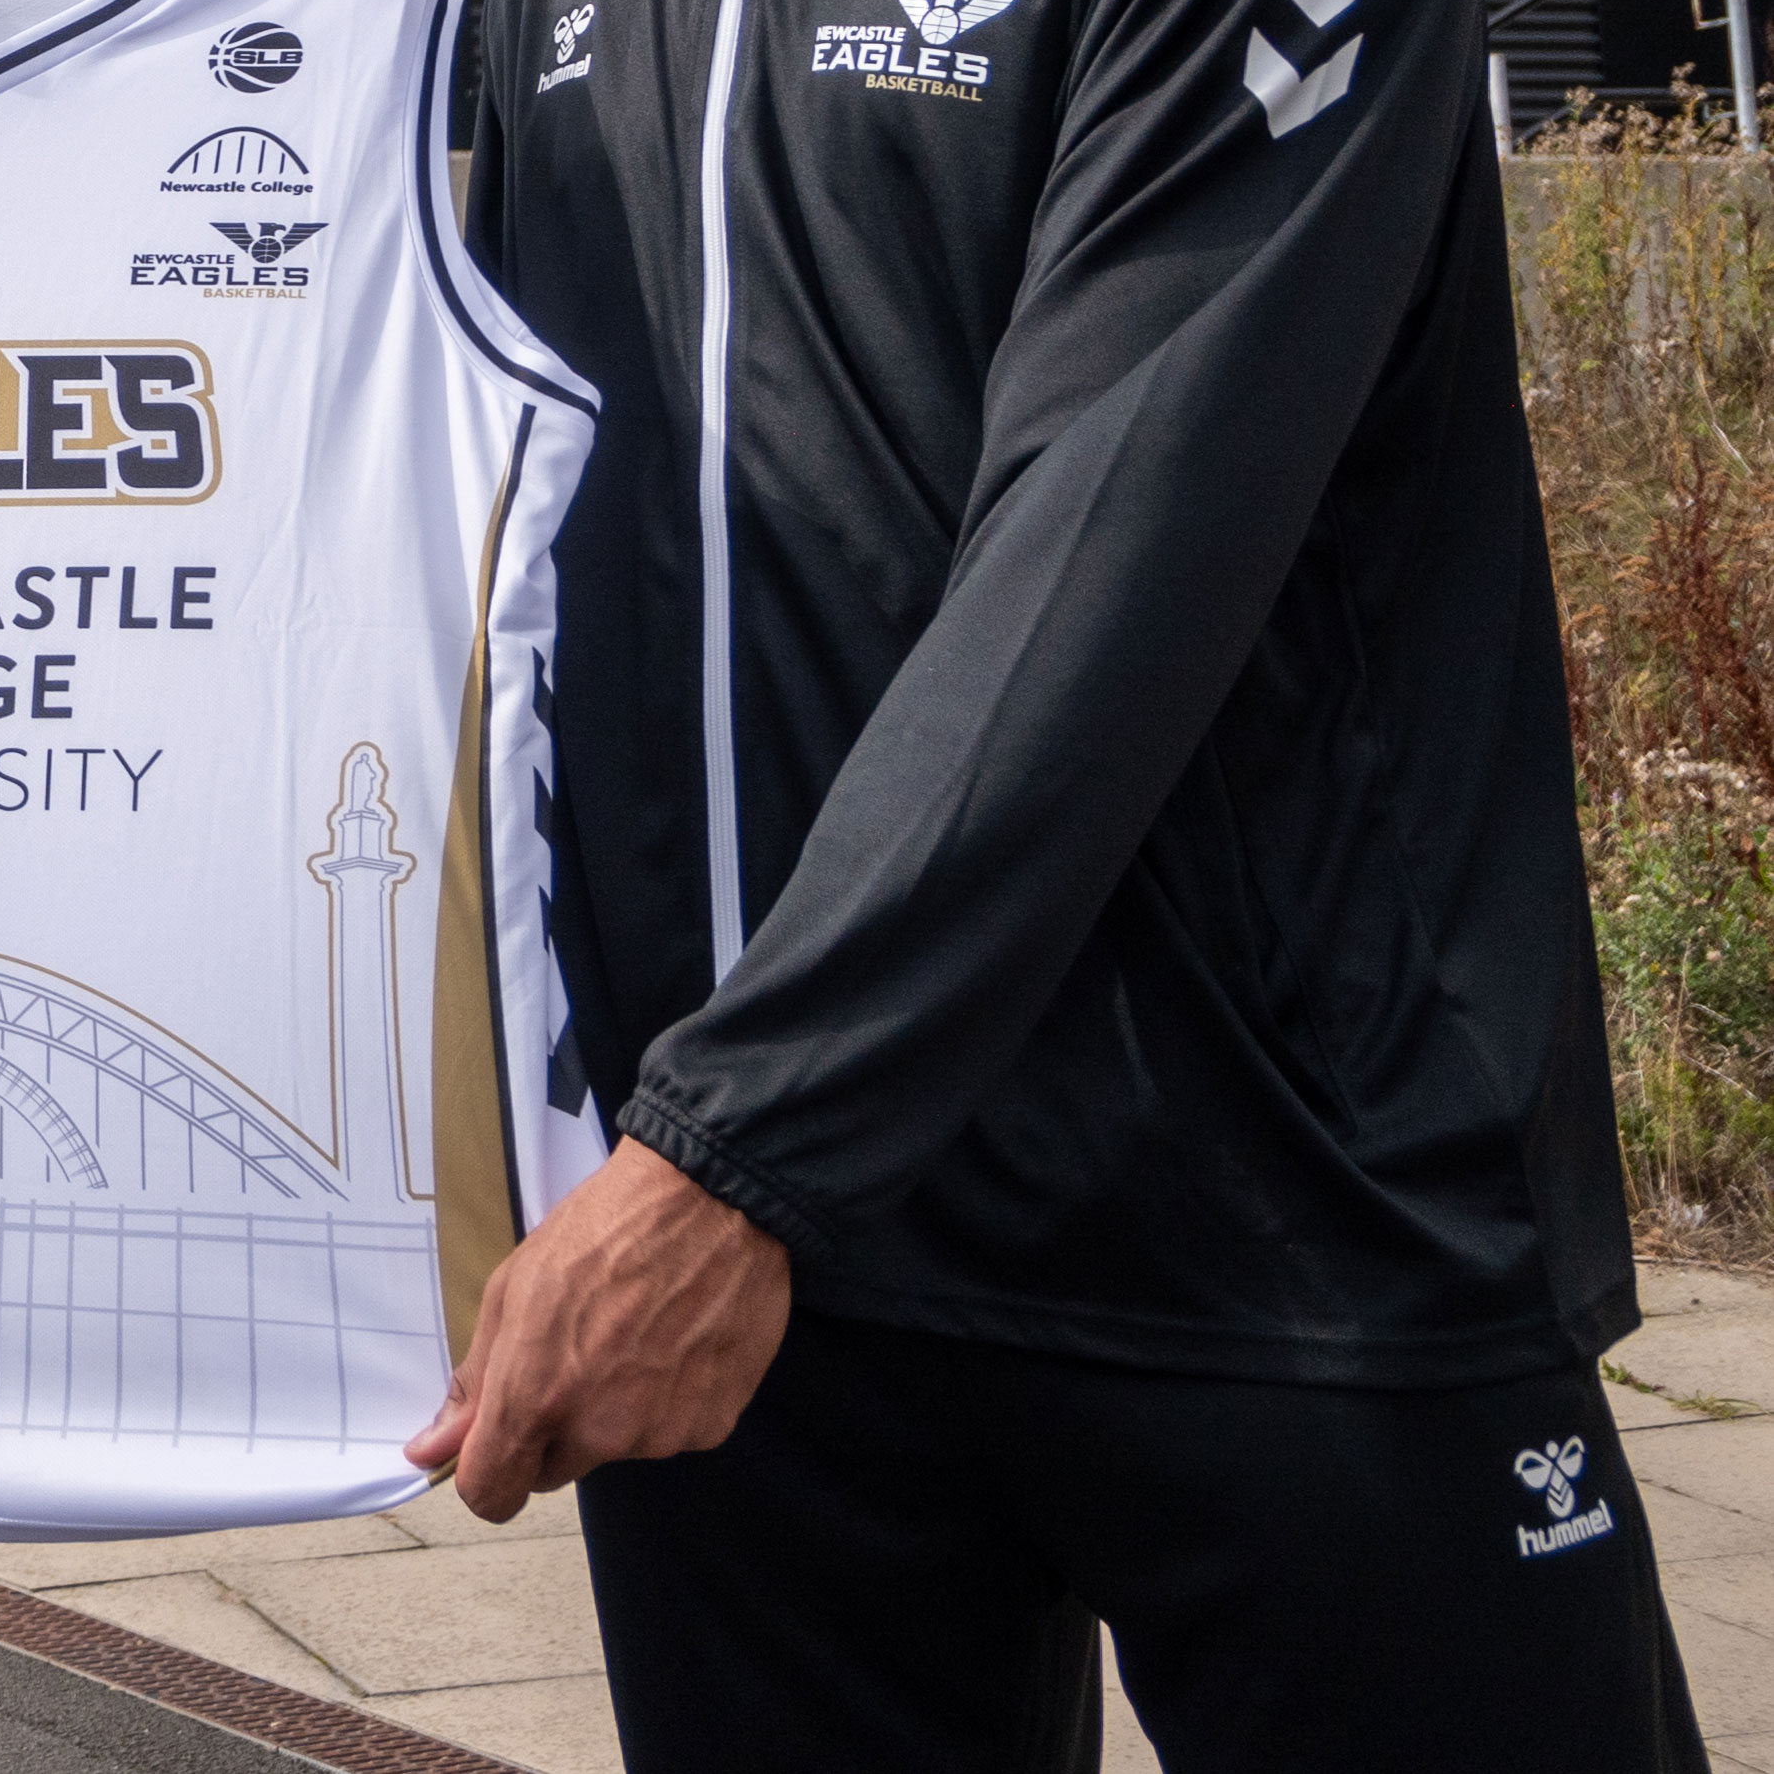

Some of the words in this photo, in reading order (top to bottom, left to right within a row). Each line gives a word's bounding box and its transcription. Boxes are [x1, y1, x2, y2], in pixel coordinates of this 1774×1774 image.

[815, 25, 907, 42] NEWCASTLE
[233, 50, 304, 65] SLB
[811, 42, 990, 85] EAGLES
[536, 52, 592, 94] hummel
[865, 73, 983, 102] BASKETBALL
[159, 180, 246, 194] Newcastle
[250, 180, 314, 197] College
[132, 253, 236, 266] NEWCASTLE
[129, 266, 310, 287] EAGLES
[202, 288, 307, 300] BASKETBALL
[1516, 1497, 1613, 1558] hummel
